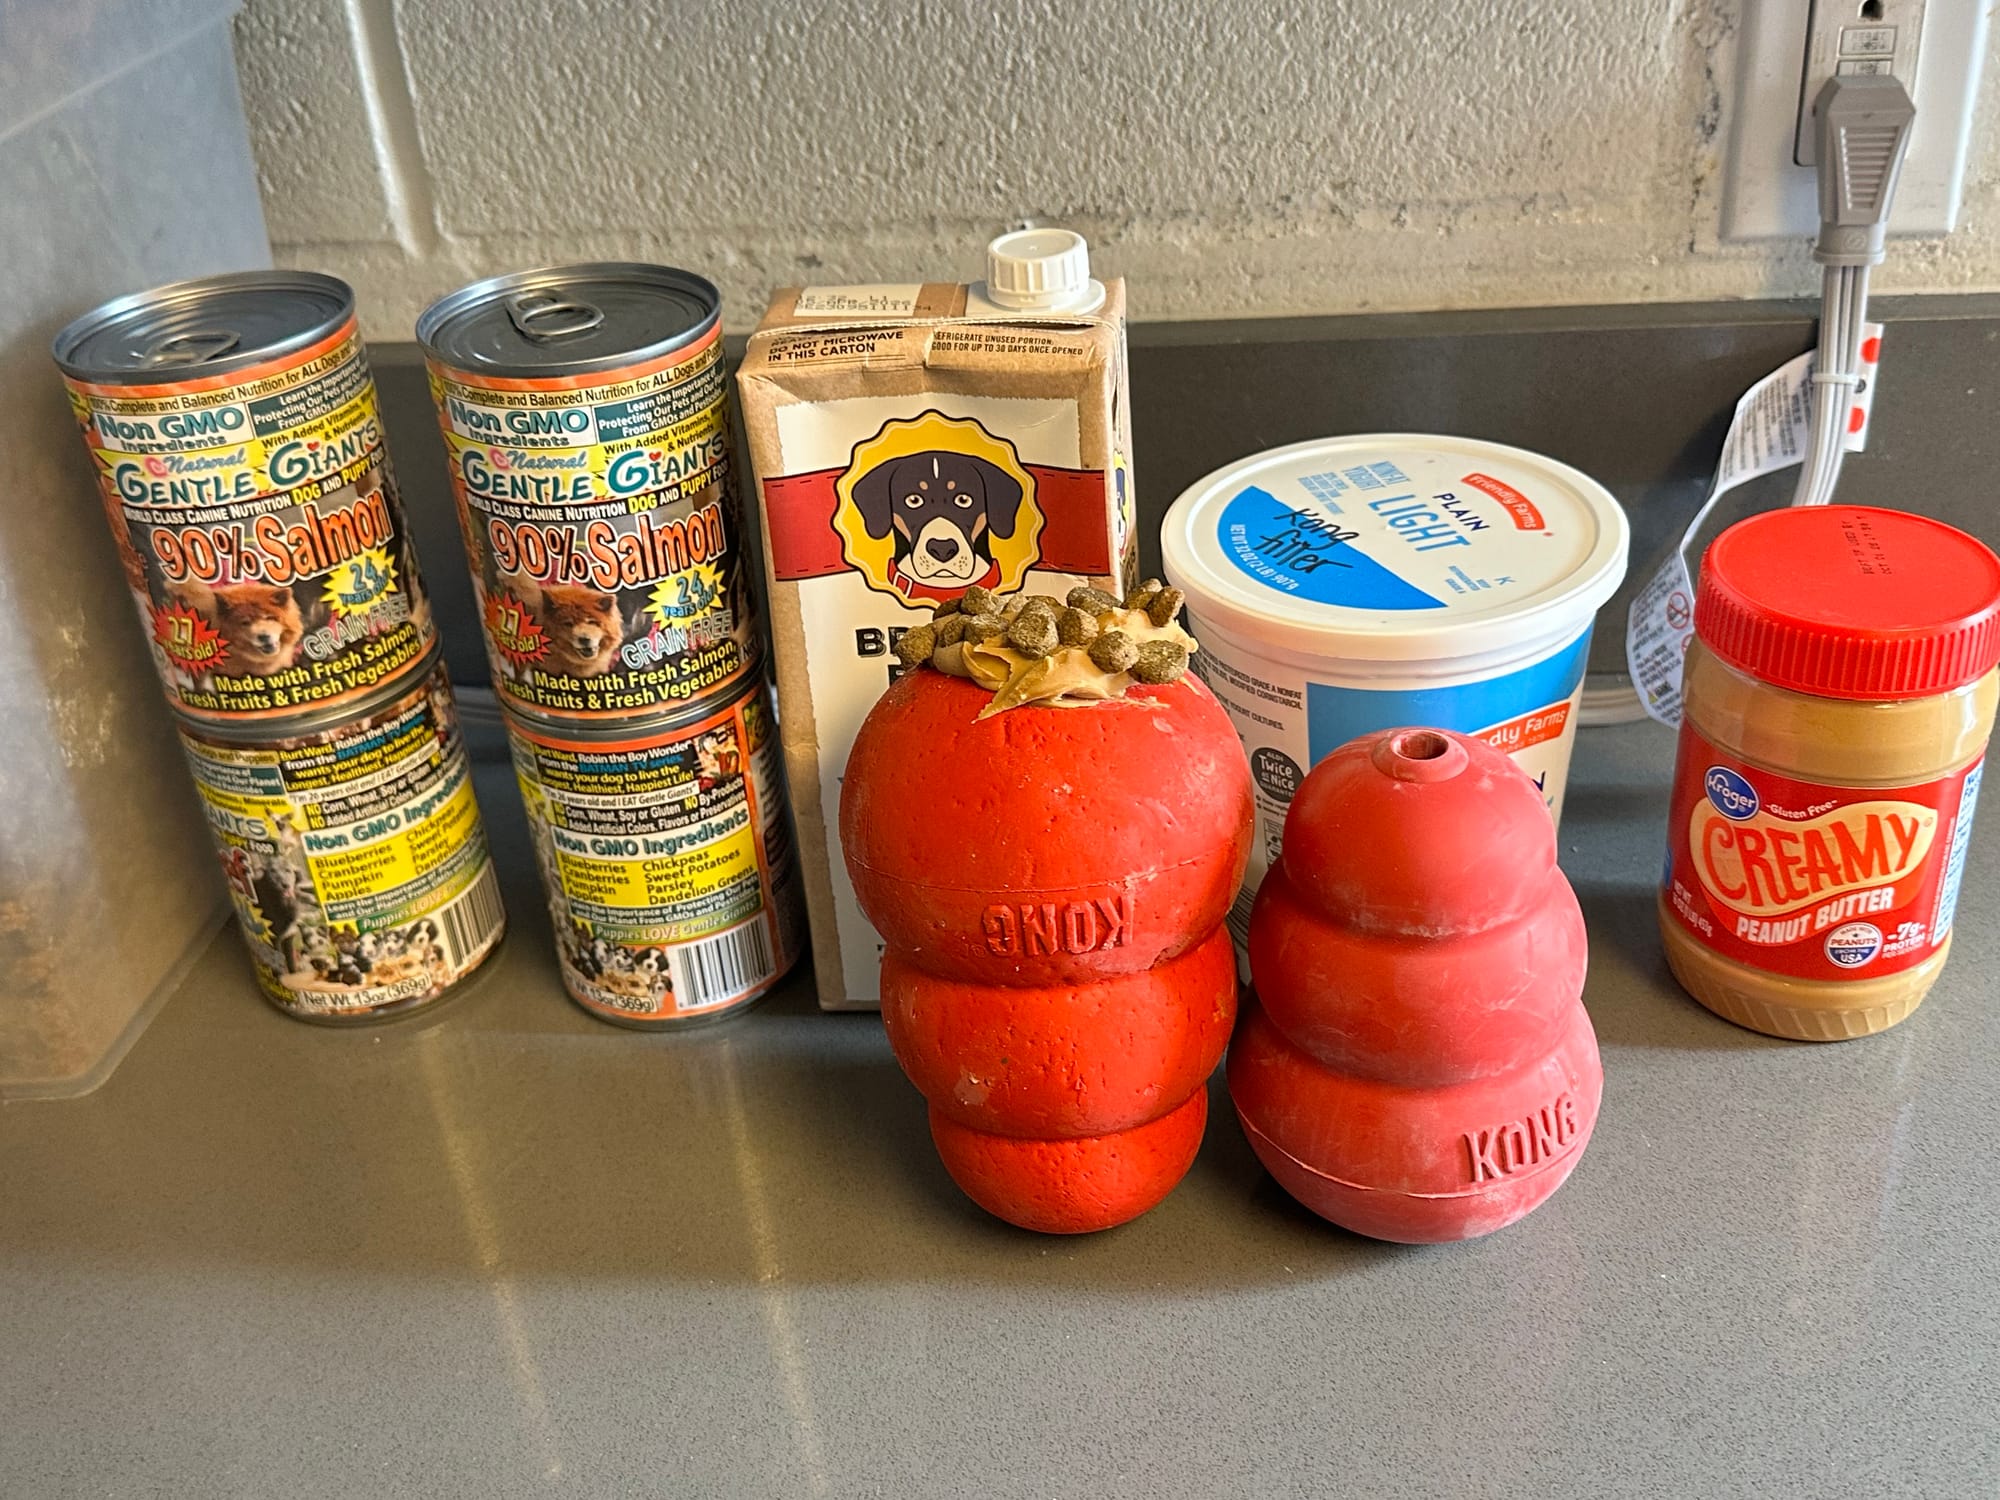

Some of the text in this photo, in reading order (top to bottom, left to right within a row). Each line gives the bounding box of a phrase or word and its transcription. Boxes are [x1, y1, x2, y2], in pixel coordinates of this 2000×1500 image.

[768, 342, 876, 362] IN THIS CARTON
[769, 345, 788, 355] DO
[792, 340, 819, 351] NOT
[823, 330, 904, 347] MICROWAVE
[931, 342, 1083, 356] GOOD FOR UP TO 30 DAYS ONCE OPENED
[984, 334, 1017, 344] UNUSED
[110, 352, 341, 415] Complete and Balanced Nutrition for ALL Dogs
[280, 384, 322, 406] Learn the
[461, 362, 694, 406] Complete and Balanced Nutrition for ALL Dogs
[254, 395, 324, 425] Protecting Our
[278, 402, 331, 430] From GMOs
[450, 400, 589, 435] Non GMO
[599, 396, 690, 430] Protecting Our Pets
[626, 400, 655, 414] Learn
[656, 392, 671, 404] the
[96, 407, 244, 440] Non GMO
[262, 421, 325, 449] With Added
[621, 405, 695, 437] From GMOs and
[603, 432, 670, 455] With Added
[667, 423, 714, 452] & Nutrients
[116, 419, 378, 505] GENTLE GIANTS
[164, 448, 246, 474] Natural
[462, 431, 725, 503] GENTLE GIANTS
[506, 451, 587, 471] Natural
[153, 459, 371, 525] CLASS CANINE NUTRITION DOG AND PUPPY
[492, 470, 712, 521] CLASS CANINE NUTRITION DOG AND PUPPY
[1468, 475, 1537, 529] Friendly Farms
[1368, 494, 1471, 552] LIGHT
[1432, 492, 1490, 532] PLAIN
[152, 490, 393, 585] 90% Salmon
[1273, 508, 1360, 551] Kong
[490, 504, 725, 590] 90% Salmon
[349, 556, 377, 592] 24
[676, 571, 703, 604] 24
[1271, 574, 1299, 590] 907g
[1494, 576, 1517, 585] K
[662, 603, 696, 620] years
[167, 616, 193, 645] 27
[303, 592, 409, 661] GRAIN FREE
[621, 609, 733, 670] GRAIN FREE
[215, 624, 417, 693] Made with Fresh Salmon,
[533, 640, 737, 692] Made with Fresh Salmon,
[180, 638, 421, 710] Fresh Fruits & Fresh Vegetables
[536, 656, 739, 710] Fruits & Fresh Vegetables
[1524, 710, 1567, 735] Farms
[627, 750, 648, 762] Boy
[1259, 754, 1293, 778] Twice
[600, 765, 680, 785] dog to live the
[626, 777, 672, 793] Happiest
[1270, 774, 1295, 791] Nice
[1707, 773, 1756, 809] Kroger
[619, 795, 698, 821] Soy or Gluten NO
[658, 815, 690, 830] Flavors
[304, 813, 400, 851] Non GMO
[590, 808, 748, 856] GMO Ingredients
[315, 843, 393, 869] Blueberries
[319, 853, 397, 879] Cranberries
[561, 850, 710, 873] Blueberries Chickpeas
[563, 848, 741, 885] Cranberries Sweet Potatoes
[1702, 813, 1919, 908] CREAMY
[322, 870, 384, 891] Pumpkin
[326, 884, 372, 901] Apples
[565, 875, 695, 895] Pumpkin Parsley
[648, 884, 715, 906] Dandelion
[717, 864, 754, 888] Greens
[982, 895, 1135, 957] KONG
[1736, 886, 1895, 944] PEANUT BUTTER
[643, 924, 680, 940] LOVE
[1830, 937, 1877, 947] PEANUTS
[1882, 933, 1925, 952] PROTEIN
[1840, 953, 1862, 963] USA
[387, 975, 430, 1001] (369g)
[615, 996, 655, 1012] (369g)
[1462, 1090, 1578, 1183] KONG
